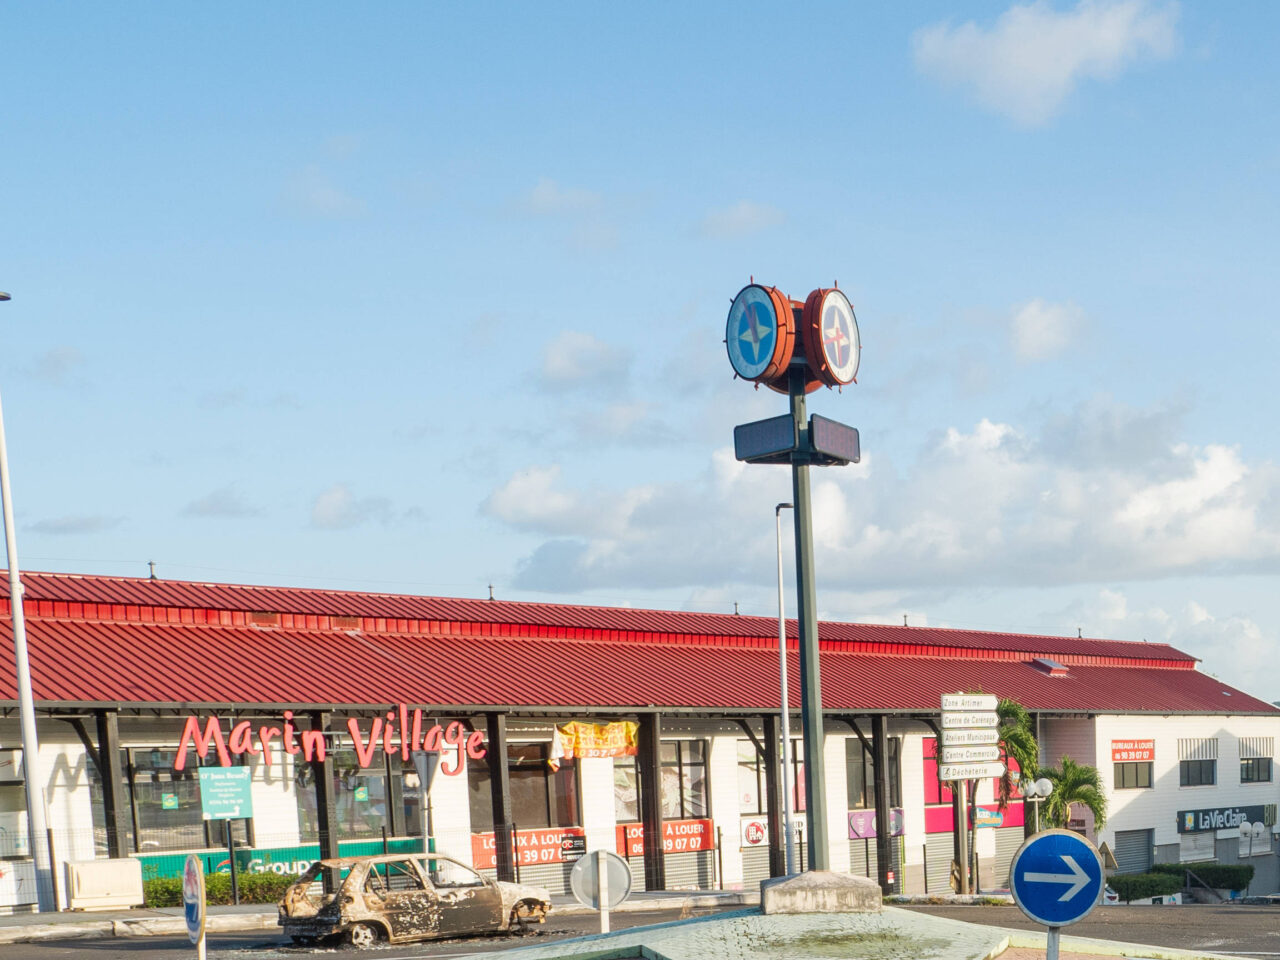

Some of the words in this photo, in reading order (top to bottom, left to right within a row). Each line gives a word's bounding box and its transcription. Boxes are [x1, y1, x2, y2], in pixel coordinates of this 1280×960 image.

[174, 710, 326, 771] Marin
[347, 702, 487, 776] Village
[666, 824, 673, 835] À
[675, 824, 704, 835] LOUER
[530, 833, 538, 845] À
[675, 838, 687, 850] 07
[690, 837, 701, 849] 07
[524, 850, 538, 862] 39
[541, 848, 554, 861] 07
